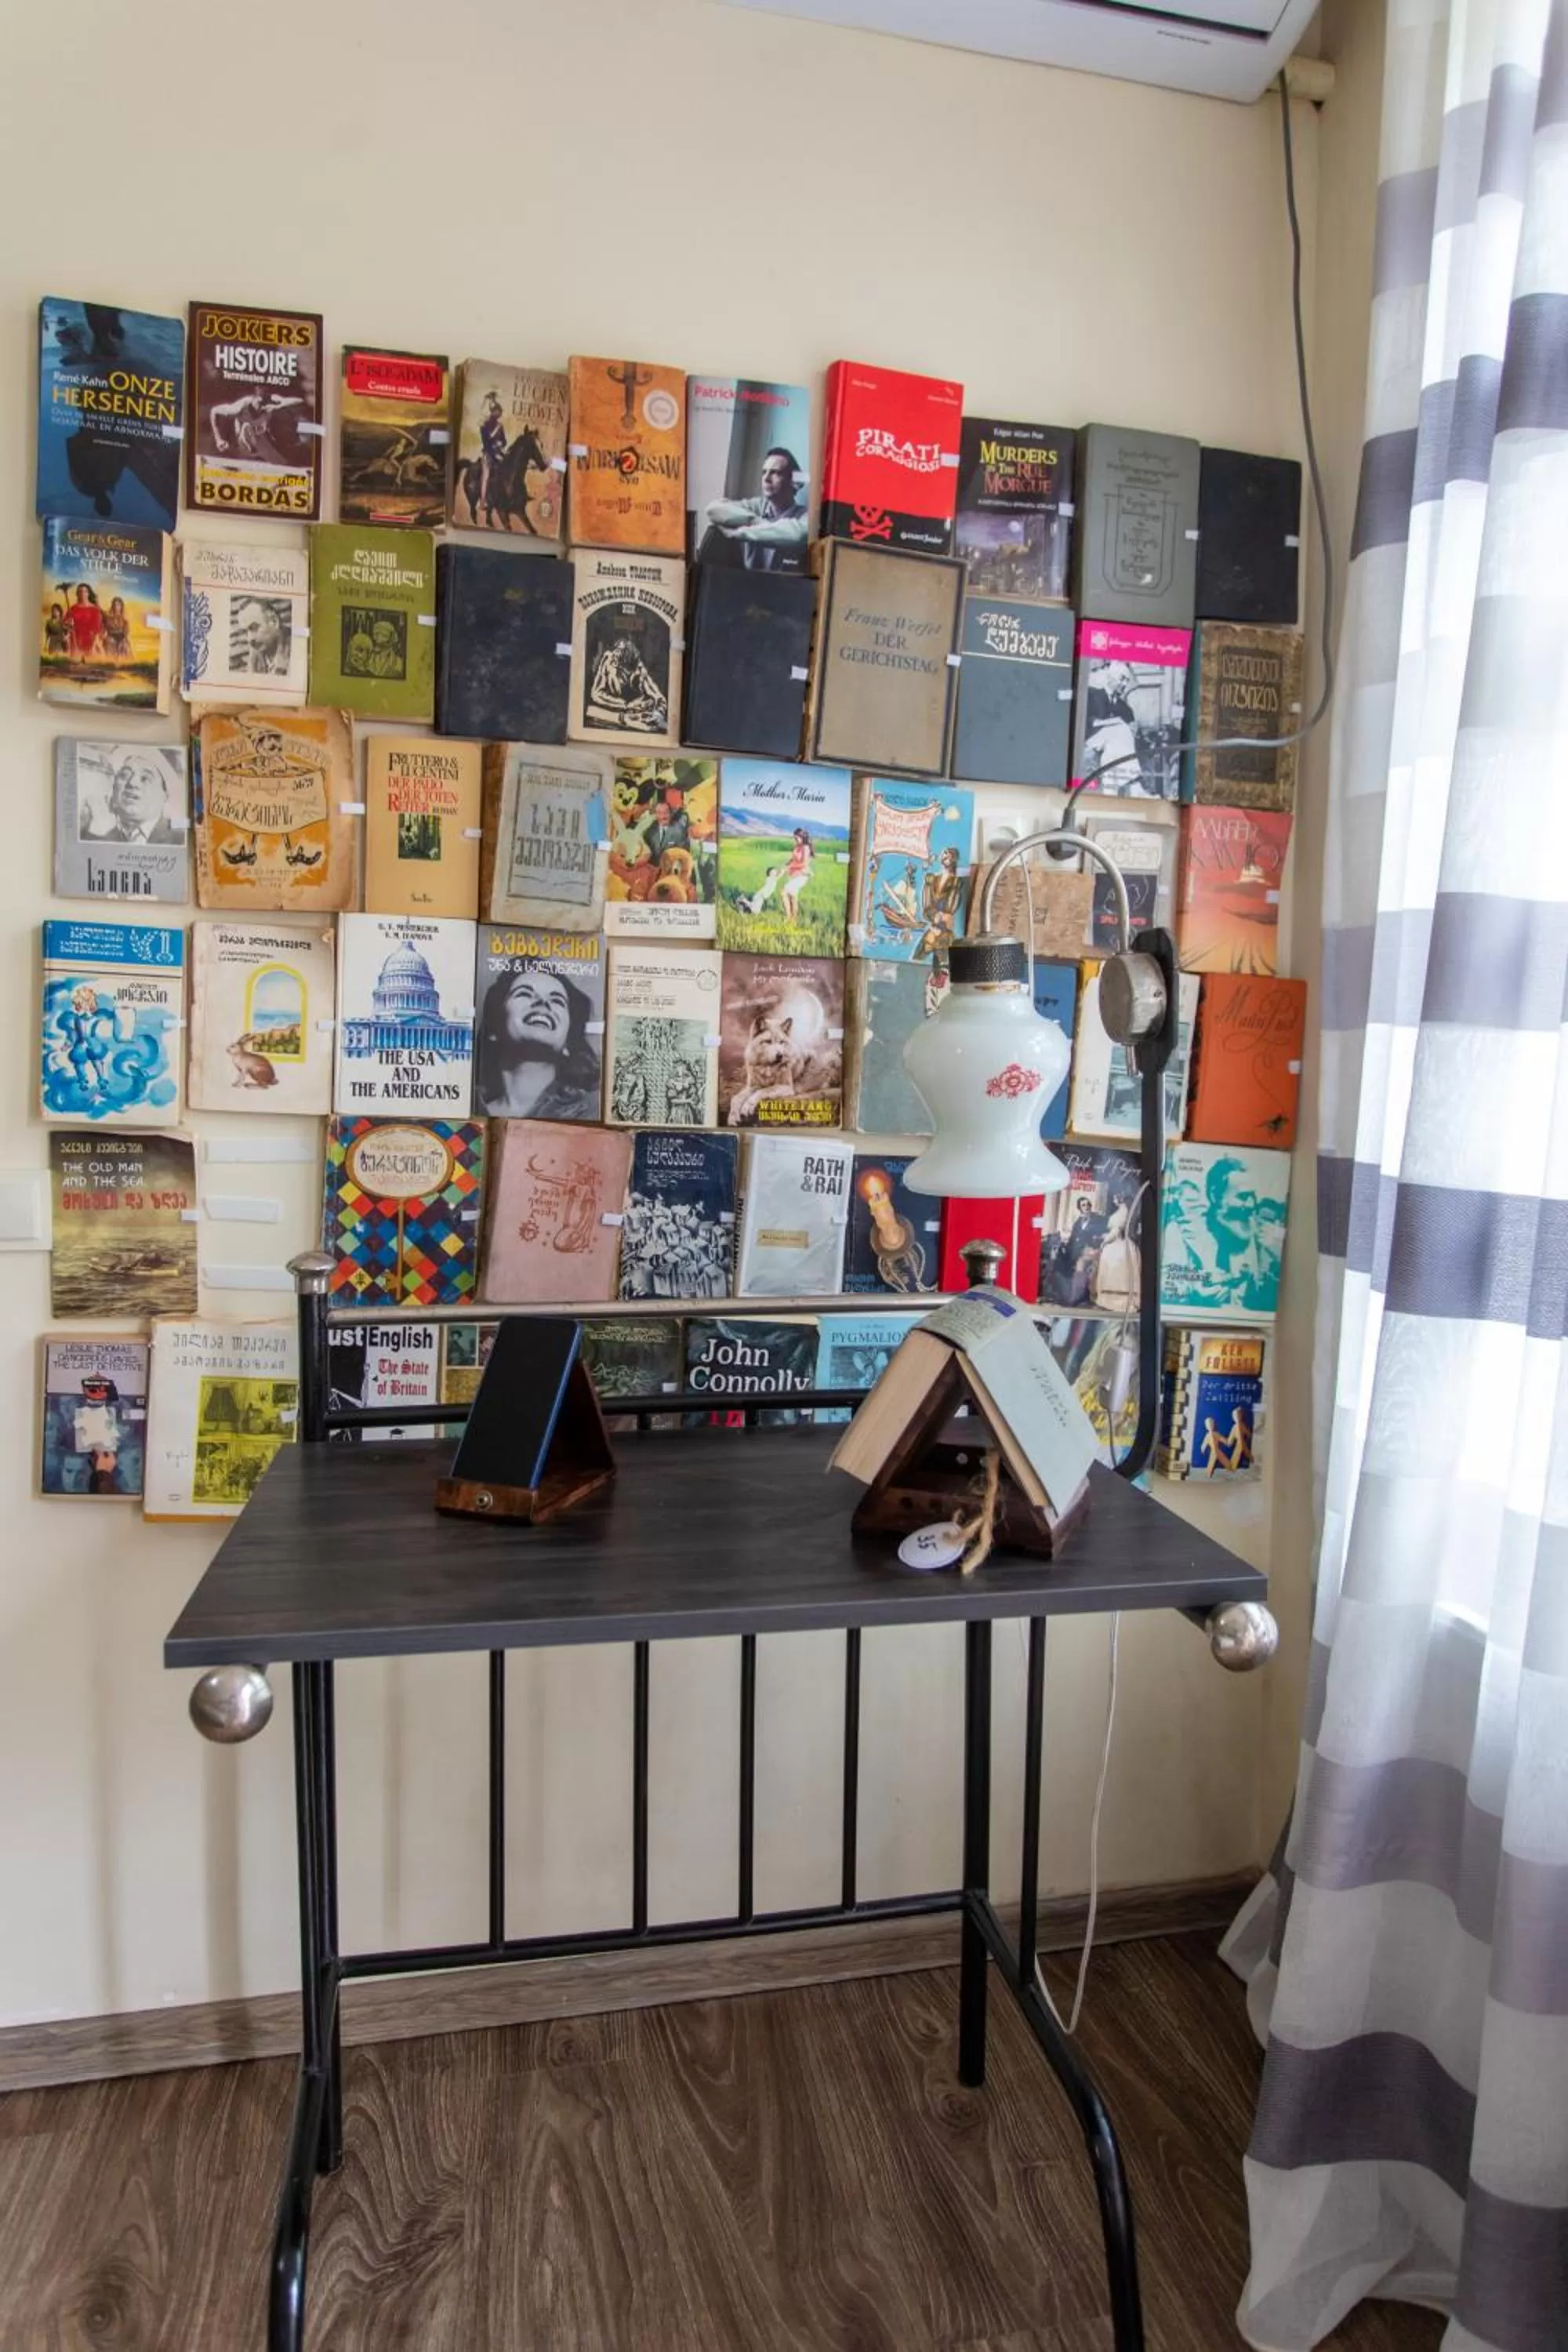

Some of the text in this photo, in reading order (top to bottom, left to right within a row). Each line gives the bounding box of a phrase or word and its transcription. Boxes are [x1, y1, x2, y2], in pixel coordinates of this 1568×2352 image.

[202, 314, 311, 346] JOKERS
[215, 344, 297, 377] HISTOIRE
[53, 370, 176, 401] René Kahn ONZE
[53, 385, 176, 424] HERSENEN
[855, 428, 941, 461] PIRATI
[200, 481, 308, 508] BORDAS
[106, 534, 138, 550] Gear
[55, 544, 151, 567] DAS VOLK DER
[844, 608, 891, 627] Franz
[874, 631, 909, 650] DER
[389, 752, 458, 771] FRUTTERO &
[388, 776, 409, 789] DER
[742, 780, 785, 800] Mother
[514, 959, 523, 973] &
[378, 1051, 435, 1066] THE USA
[392, 1067, 421, 1082] AND
[350, 1082, 460, 1100] THE AMERICANS
[62, 1161, 143, 1174] THE OLD MAN
[803, 1156, 844, 1177] RATH
[62, 1175, 143, 1187] AND THE SEA
[125, 1192, 143, 1210] და
[328, 1326, 434, 1353] ust English
[700, 1338, 770, 1367] John
[379, 1358, 430, 1375] The State
[377, 1379, 428, 1396] of Britain
[688, 1365, 811, 1393] Connolly
